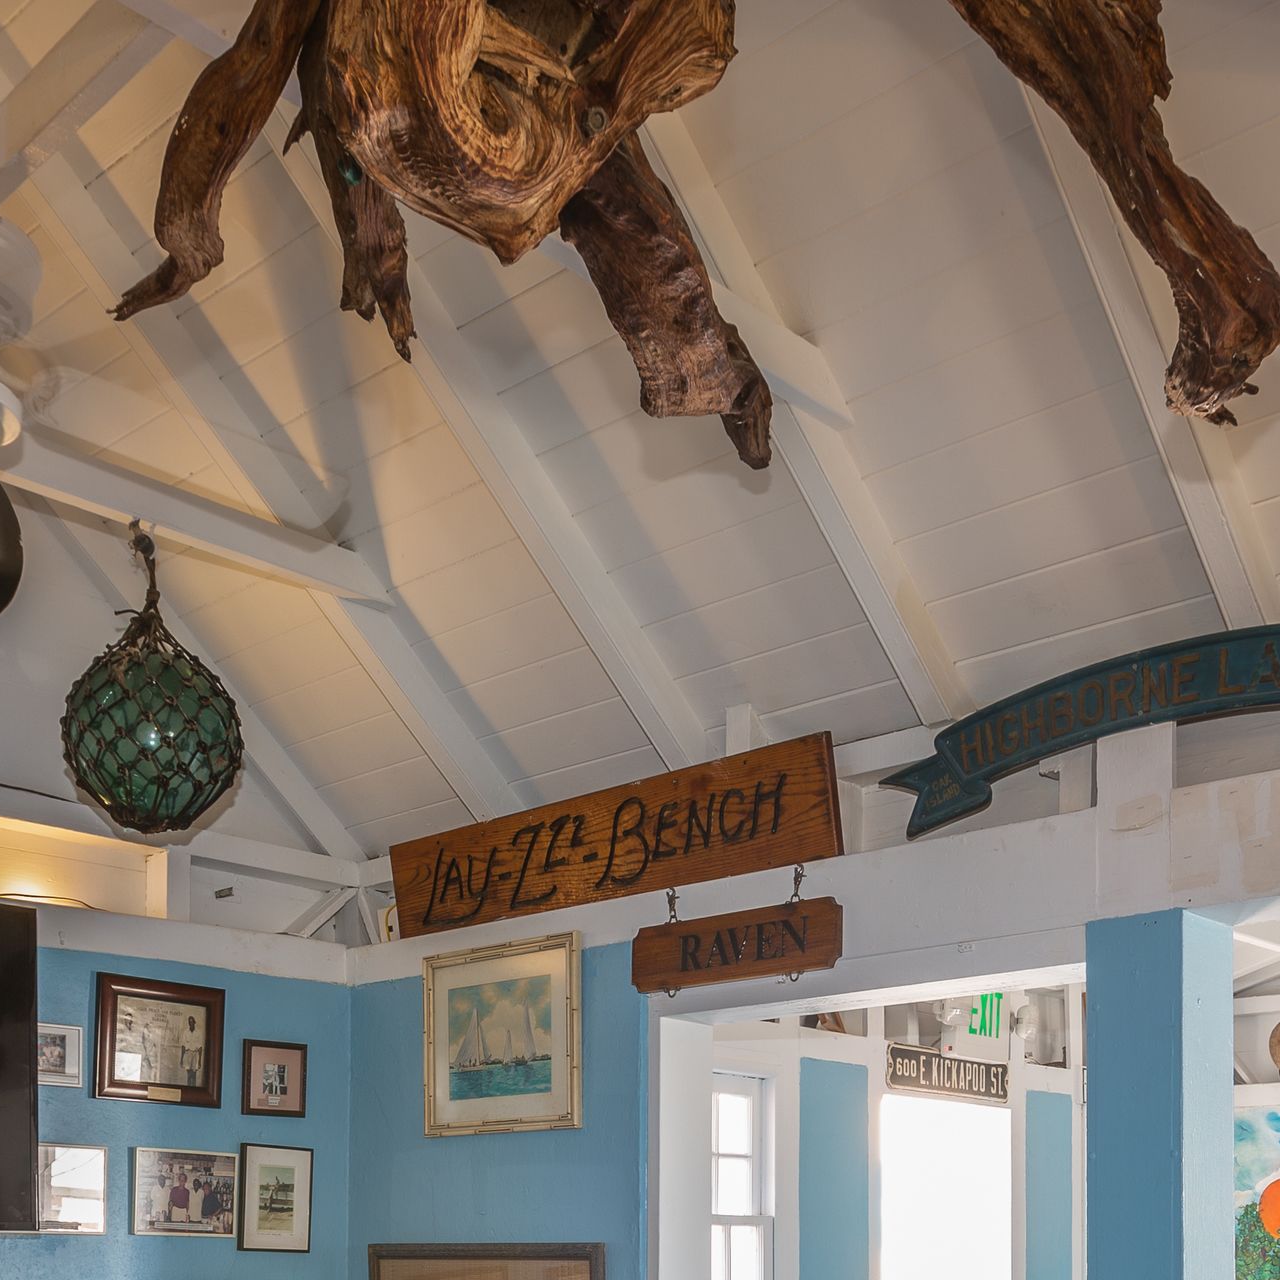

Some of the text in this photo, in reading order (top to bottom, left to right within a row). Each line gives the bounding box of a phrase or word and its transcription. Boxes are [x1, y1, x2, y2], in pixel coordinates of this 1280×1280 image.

[958, 652, 1201, 774] HIGHBORNE
[678, 915, 810, 972] RAVEN
[968, 992, 1004, 1039] EXIT
[895, 1055, 1004, 1096] 600 E. KICKAPOO ST.
